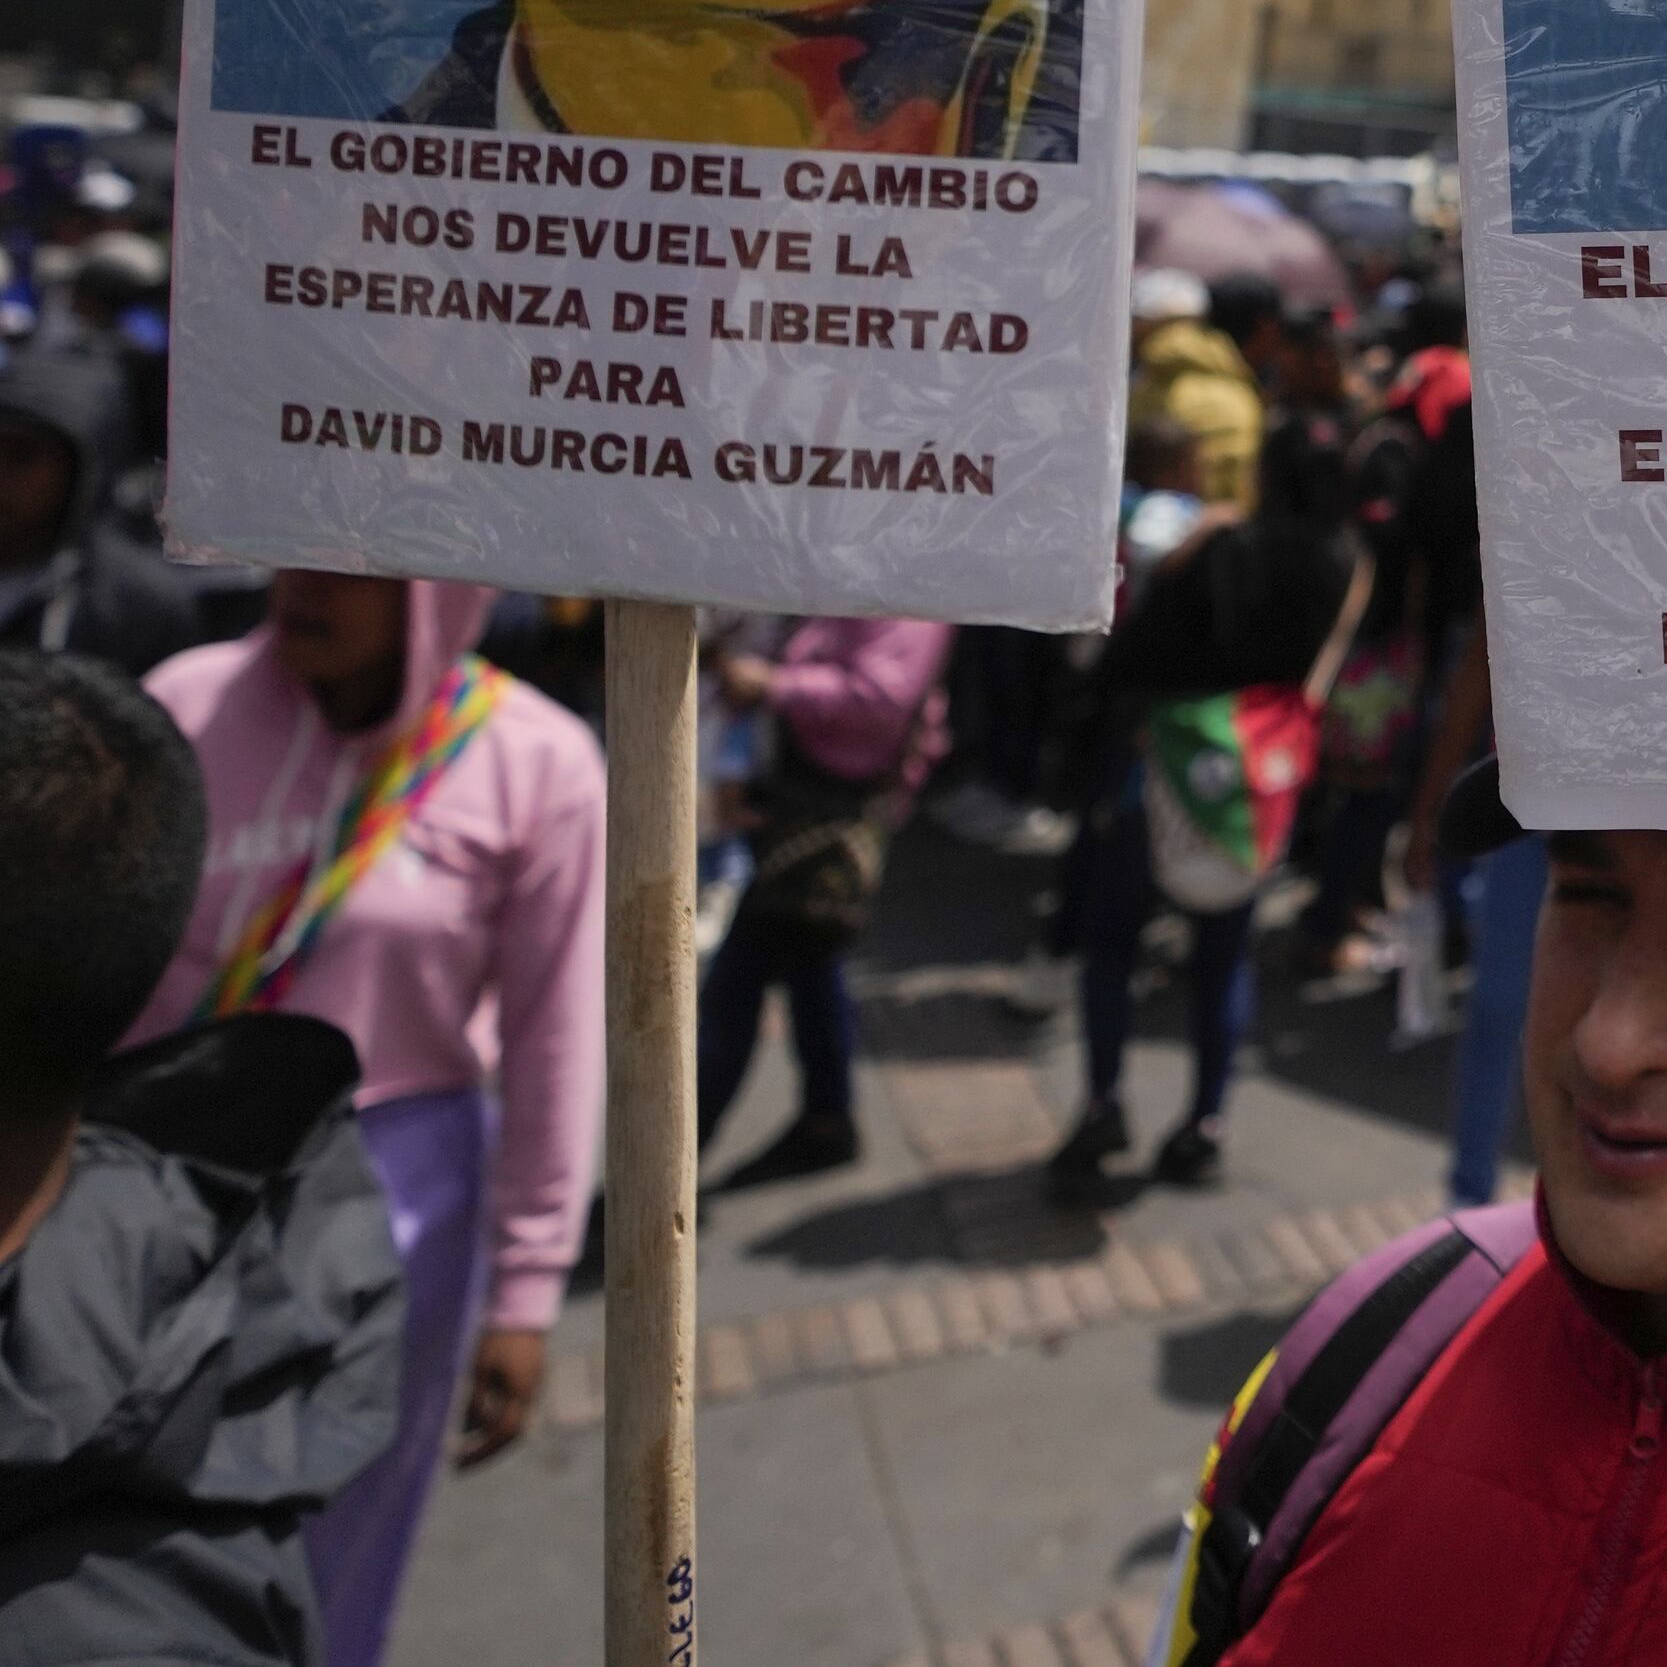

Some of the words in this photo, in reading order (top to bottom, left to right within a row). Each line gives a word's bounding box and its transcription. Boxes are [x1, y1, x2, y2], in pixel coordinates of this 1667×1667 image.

[251, 124, 312, 169] EL
[329, 130, 629, 190] GOBIERNO
[650, 151, 762, 199] DEL
[783, 160, 1039, 214] CAMBIO
[362, 202, 474, 251] NOS
[495, 212, 812, 273] DEVUELVE
[835, 234, 913, 279] LA
[264, 262, 591, 330] ESPERANZA
[612, 291, 688, 337] DE
[709, 297, 1029, 355] LIBERTAD
[529, 356, 686, 408] PARA
[280, 402, 443, 456] DAVID
[462, 420, 693, 480] MURCIA
[713, 440, 995, 496] GUZMÁN
